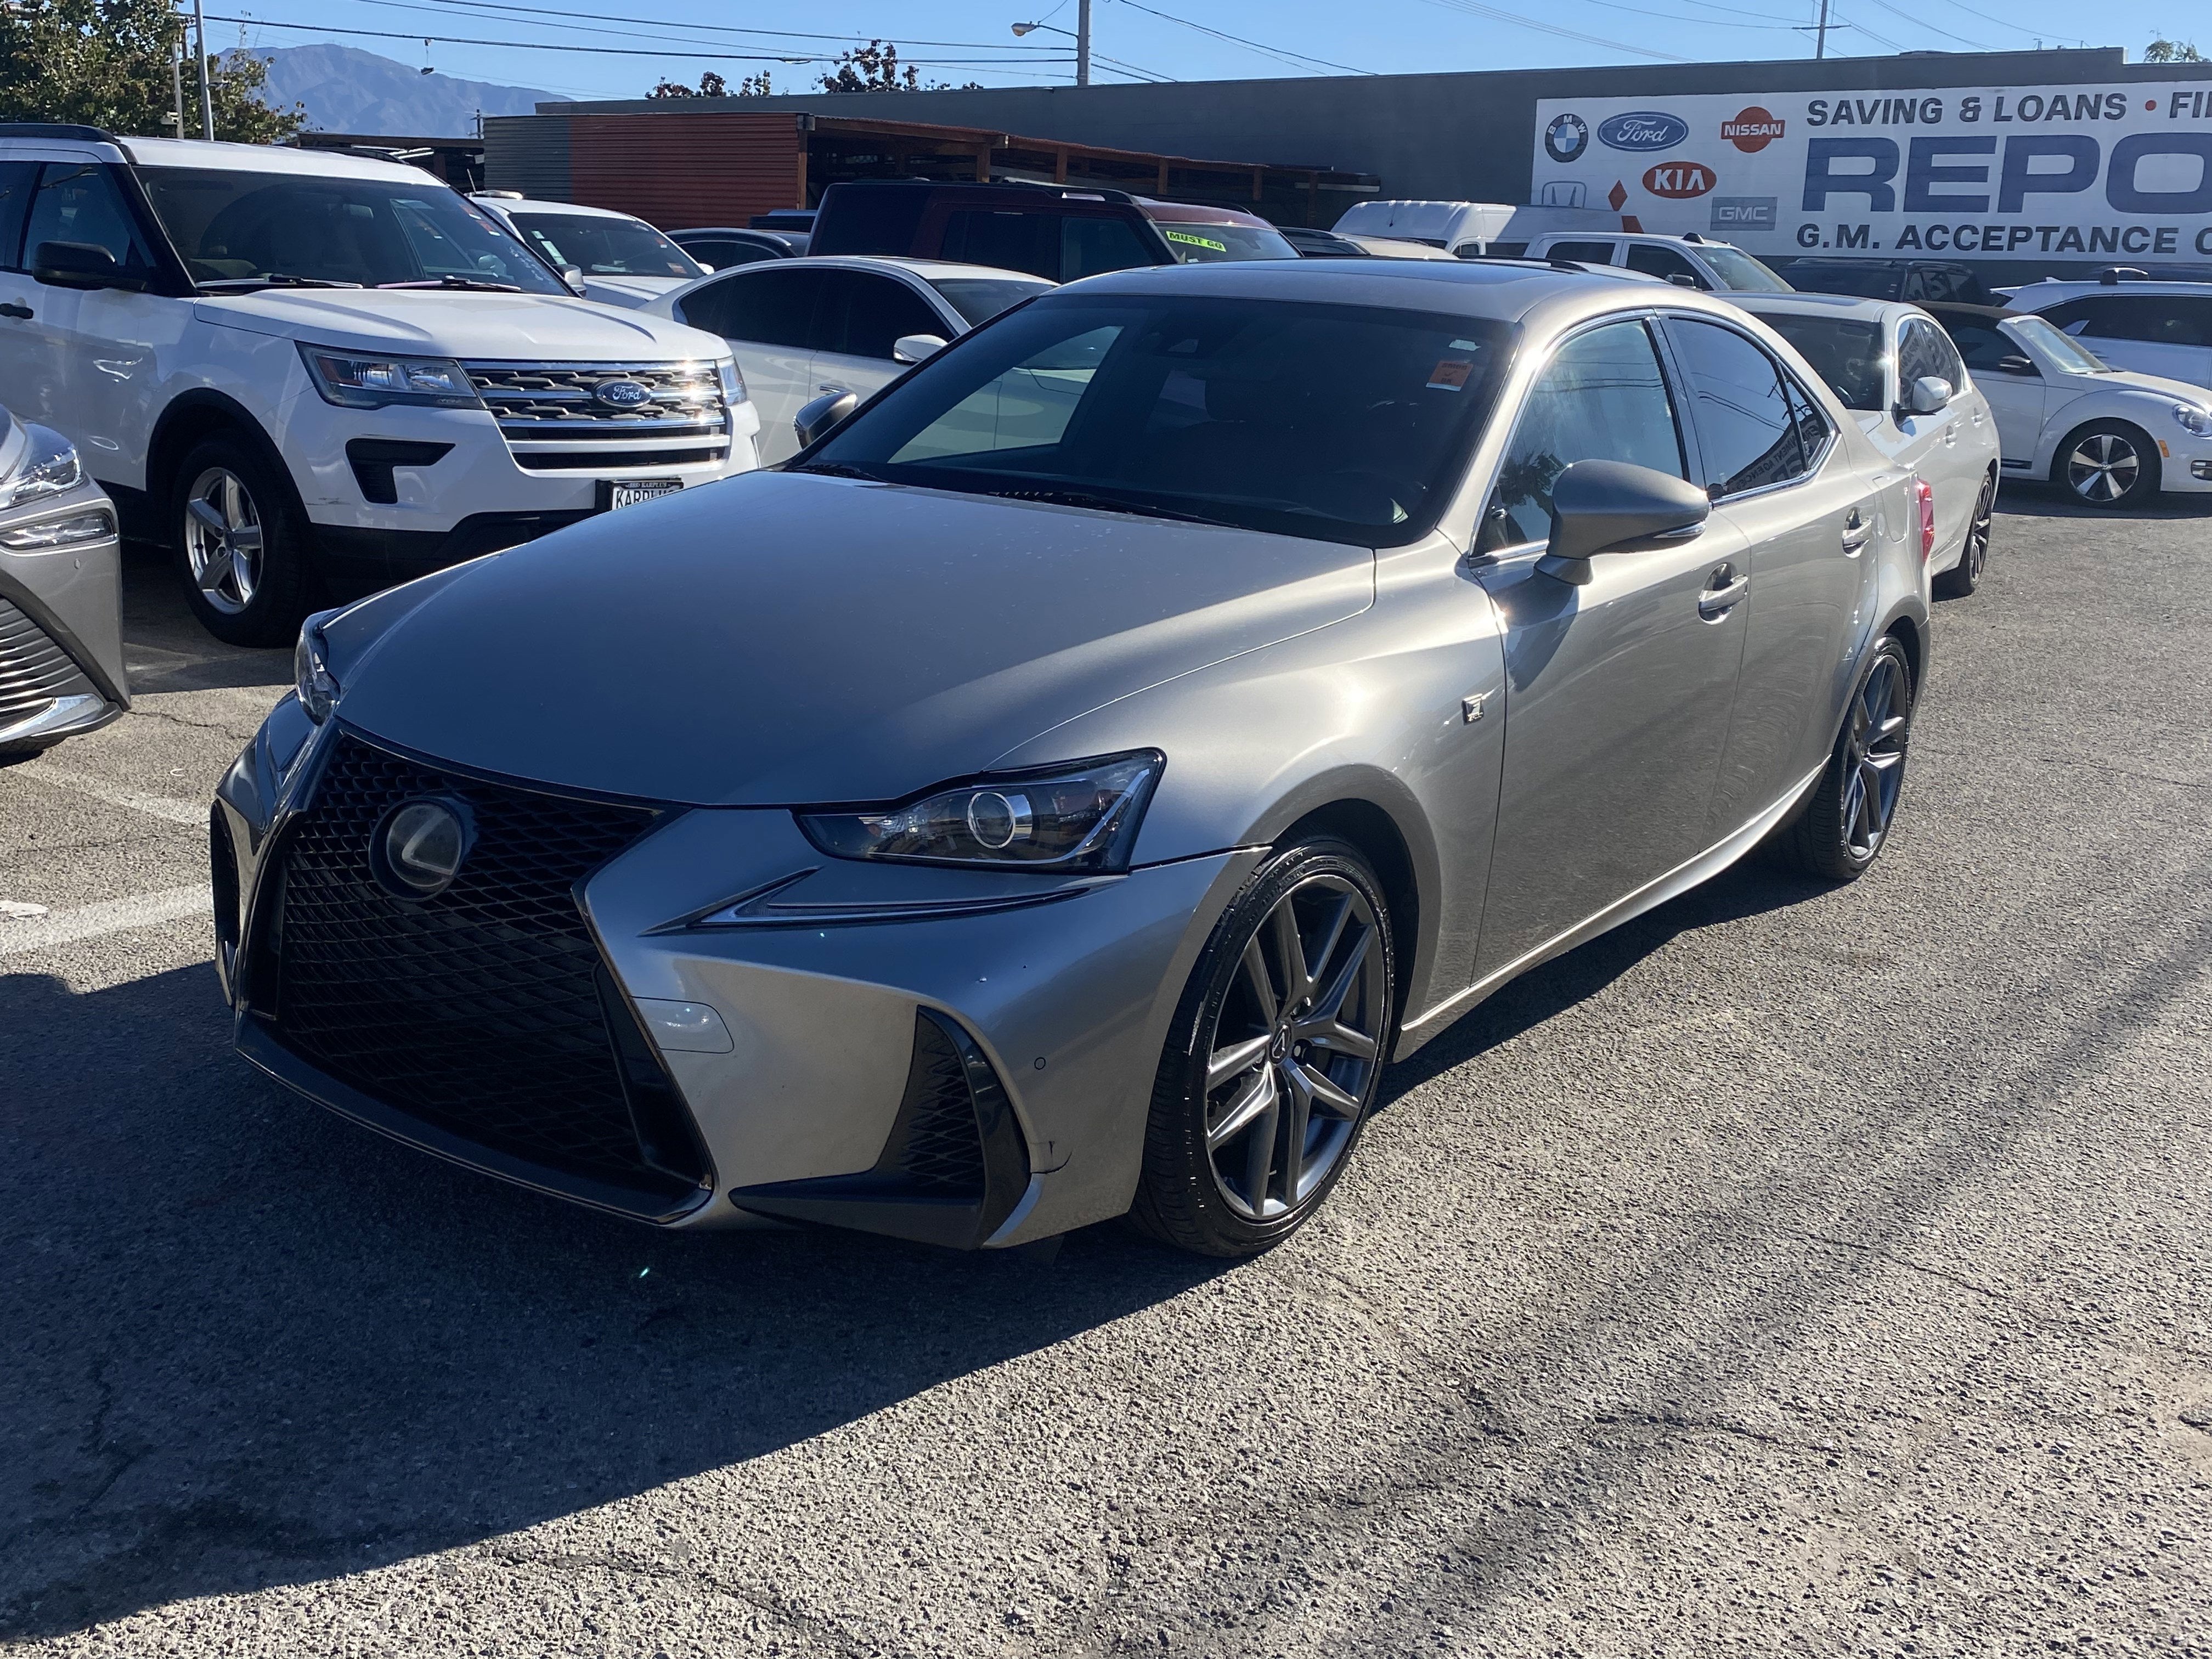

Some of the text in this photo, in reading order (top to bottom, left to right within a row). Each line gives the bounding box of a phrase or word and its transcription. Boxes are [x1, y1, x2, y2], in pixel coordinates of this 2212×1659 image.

[1807, 98, 1943, 126] SAVING
[1959, 97, 1982, 122] &
[1994, 93, 2127, 122] LOANS
[1548, 114, 1588, 135] BMW
[1616, 119, 1668, 143] Ford
[1724, 123, 1781, 137] NISSAN
[1654, 169, 1706, 190] KIA
[1802, 132, 2212, 214] REPO
[1718, 206, 1768, 220] GMC
[1169, 232, 1222, 249] MUST GO
[1797, 223, 1880, 249] G.M.
[1895, 224, 2179, 253] ACCEPTANCE
[612, 385, 642, 400] Ford
[616, 489, 674, 509] KARP
